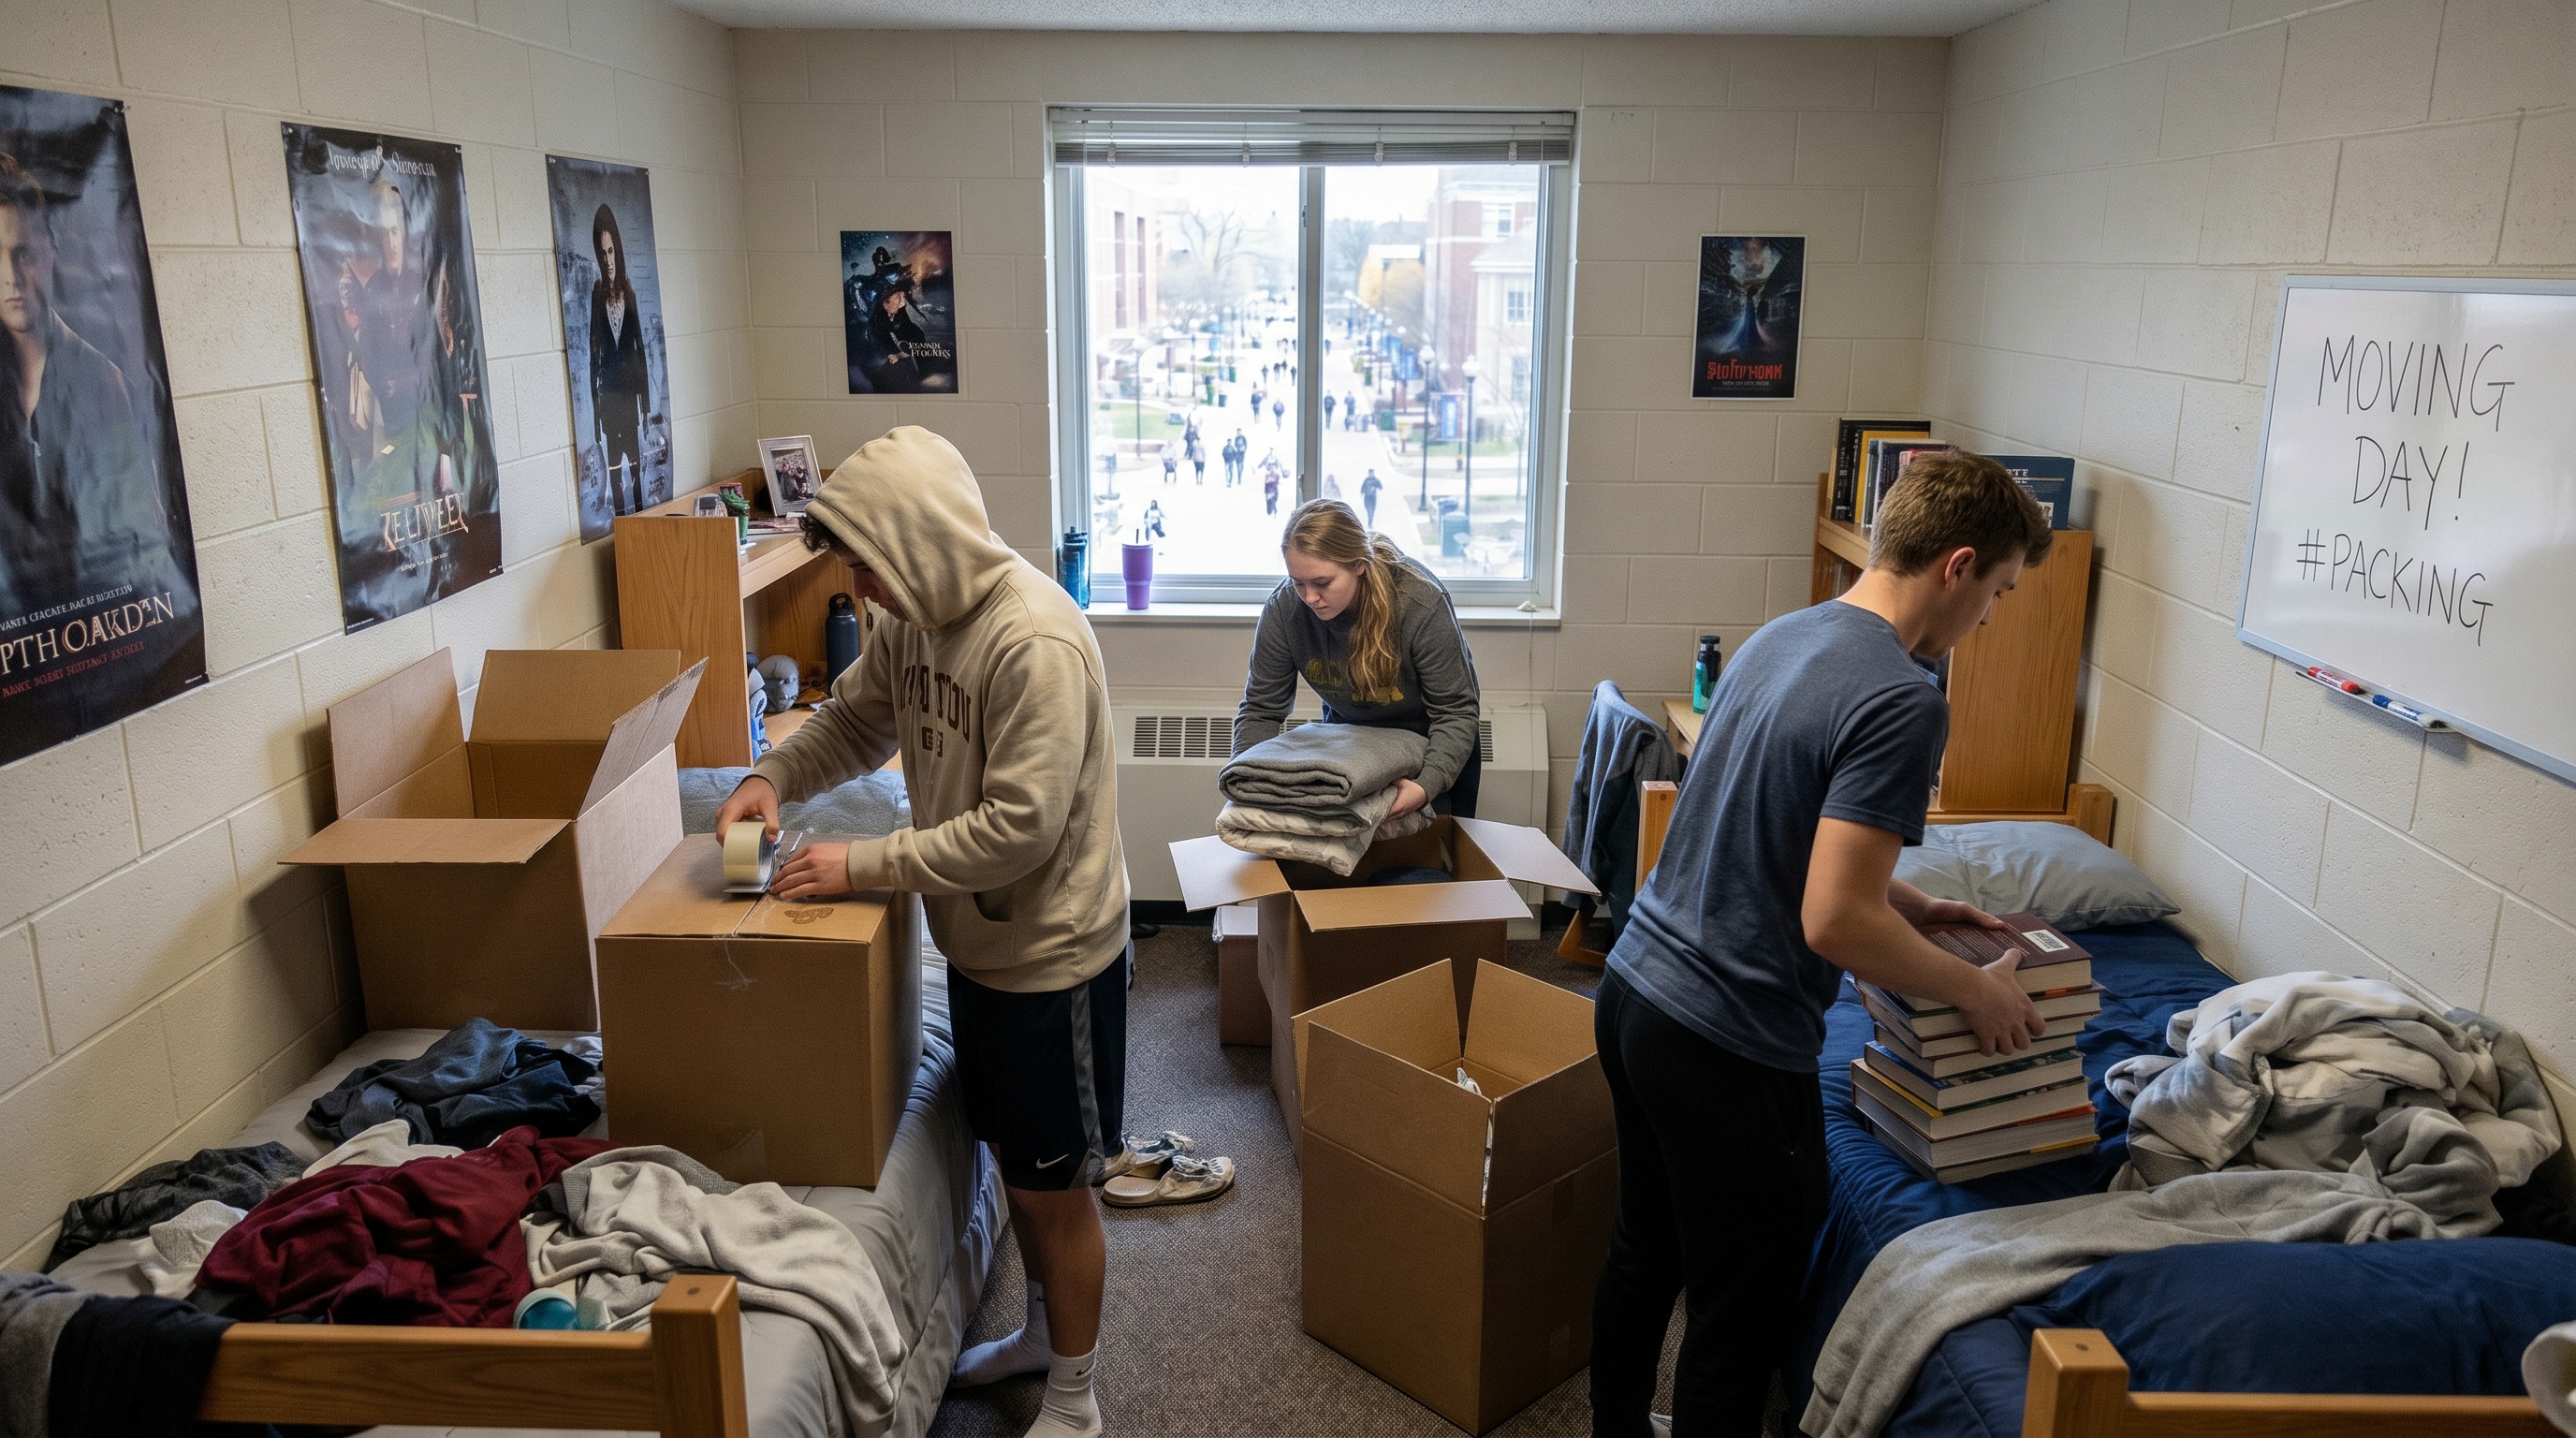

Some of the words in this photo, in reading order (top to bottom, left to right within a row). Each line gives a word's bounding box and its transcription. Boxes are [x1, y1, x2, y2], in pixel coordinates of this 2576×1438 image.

[2317, 334, 2516, 433] MOVING
[2352, 434, 2470, 531] DAY!
[2296, 528, 2495, 647] #PACKING
